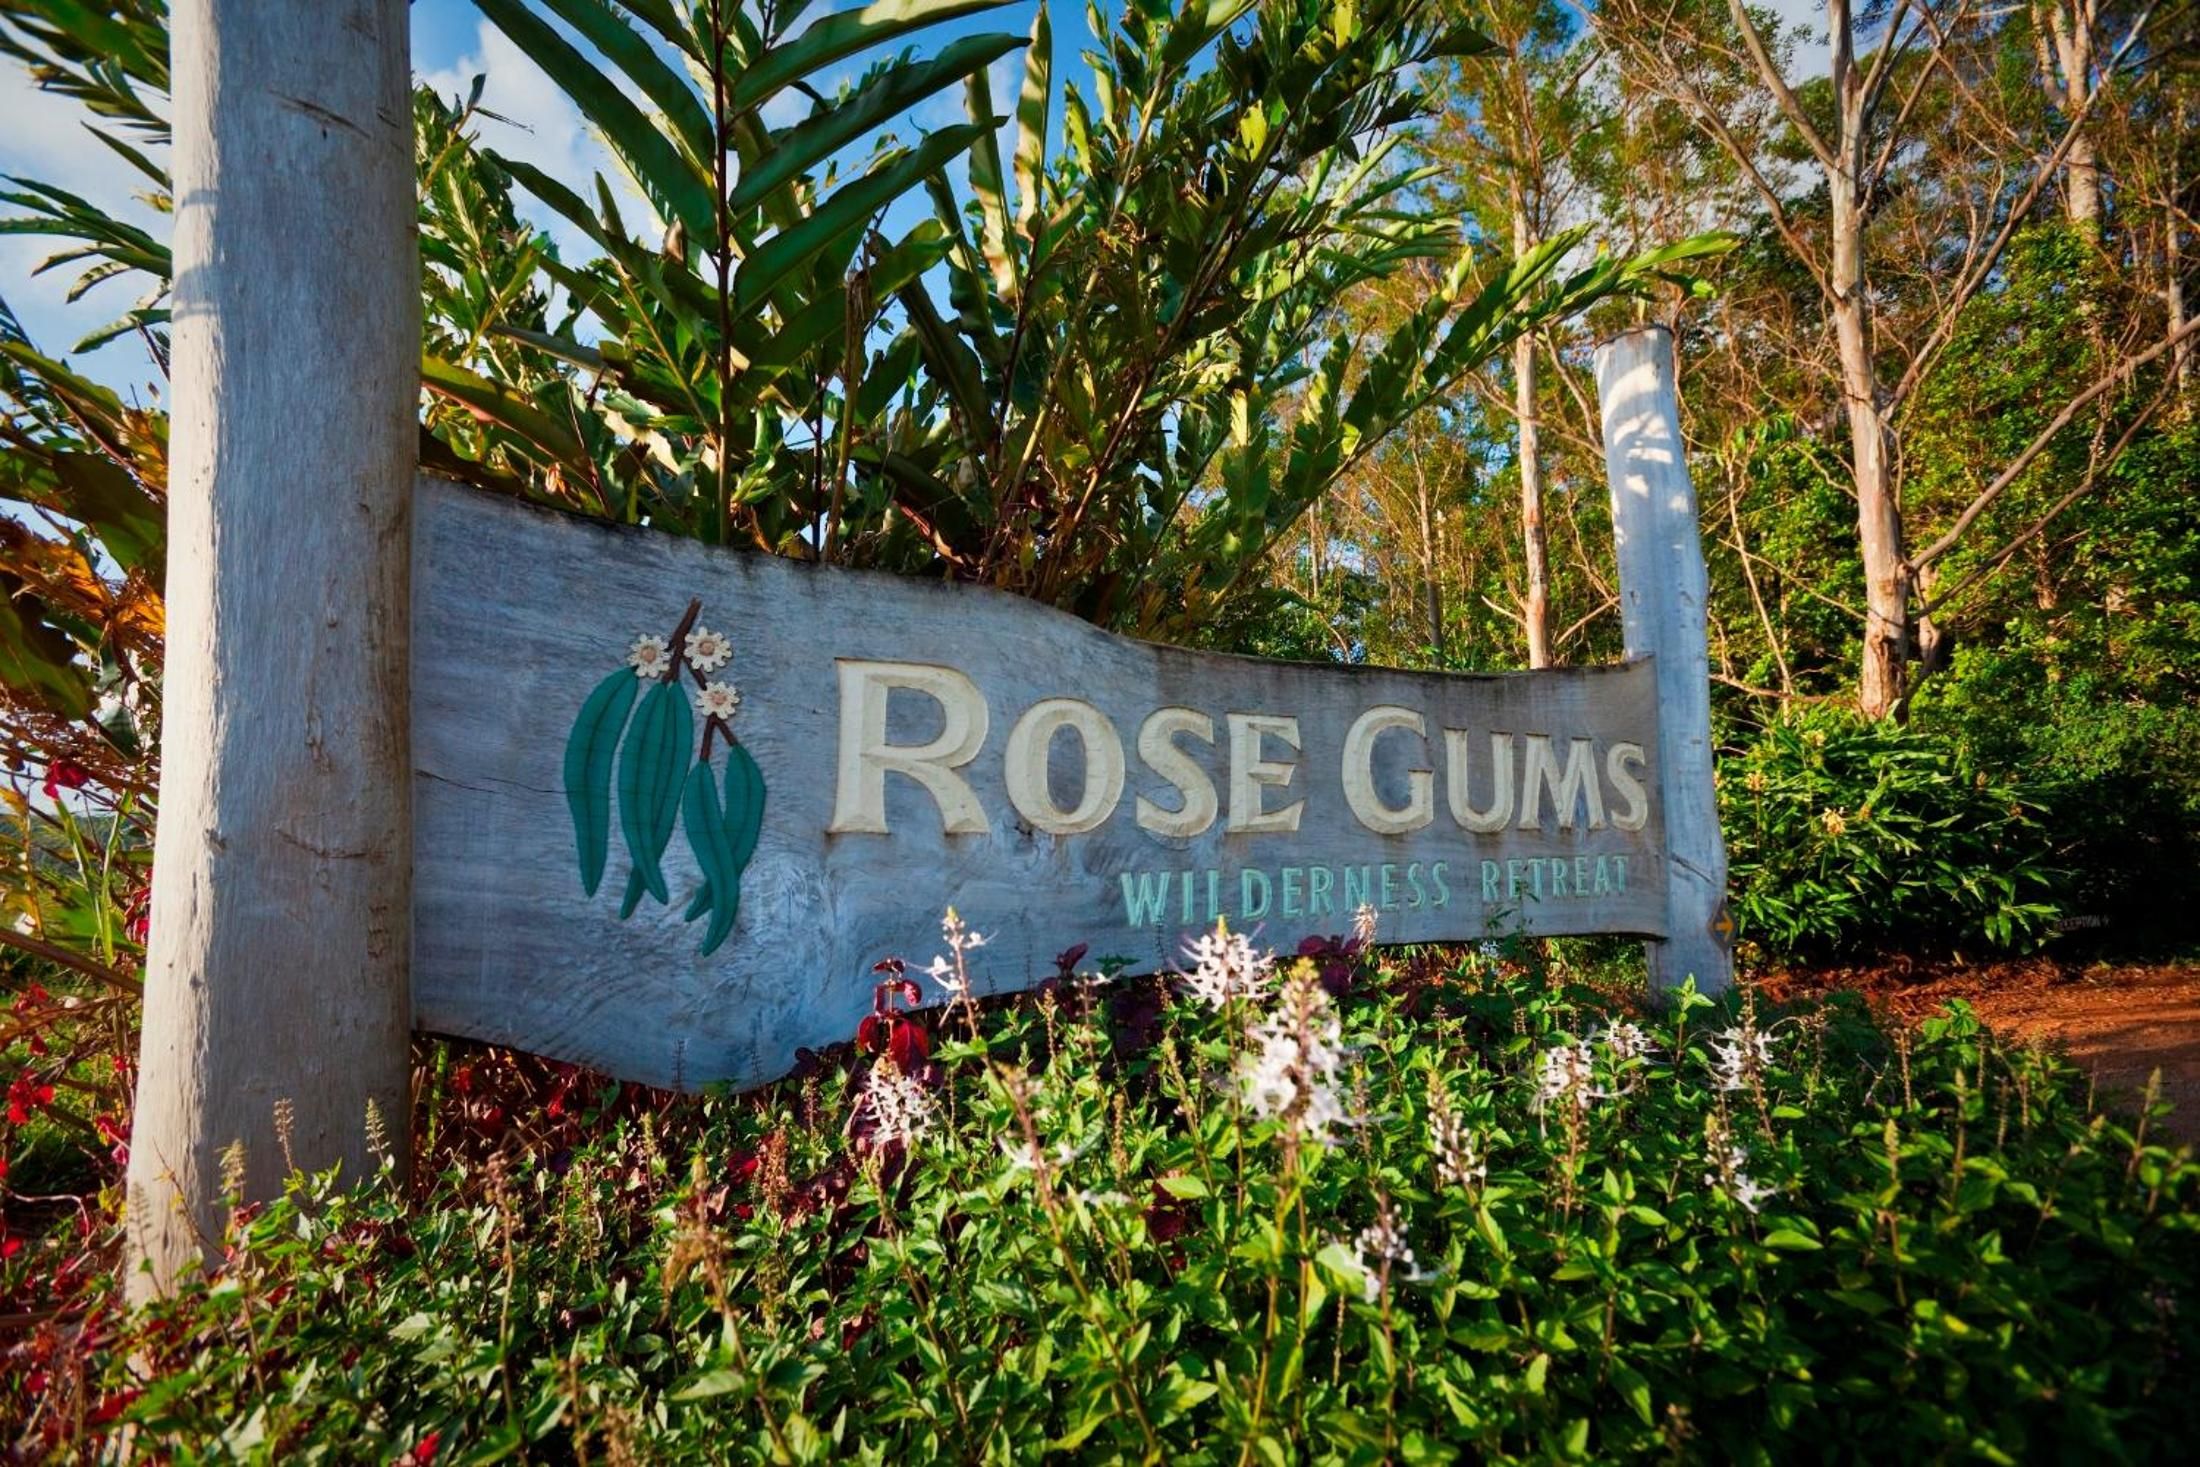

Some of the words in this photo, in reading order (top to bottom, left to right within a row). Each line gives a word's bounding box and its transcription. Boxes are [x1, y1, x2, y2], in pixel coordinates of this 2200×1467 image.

[825, 657, 1305, 836] ROSE
[1341, 704, 1649, 835] GUMS
[1120, 861, 1450, 928] WILDERNESS
[1481, 855, 1629, 901] RETREAT
